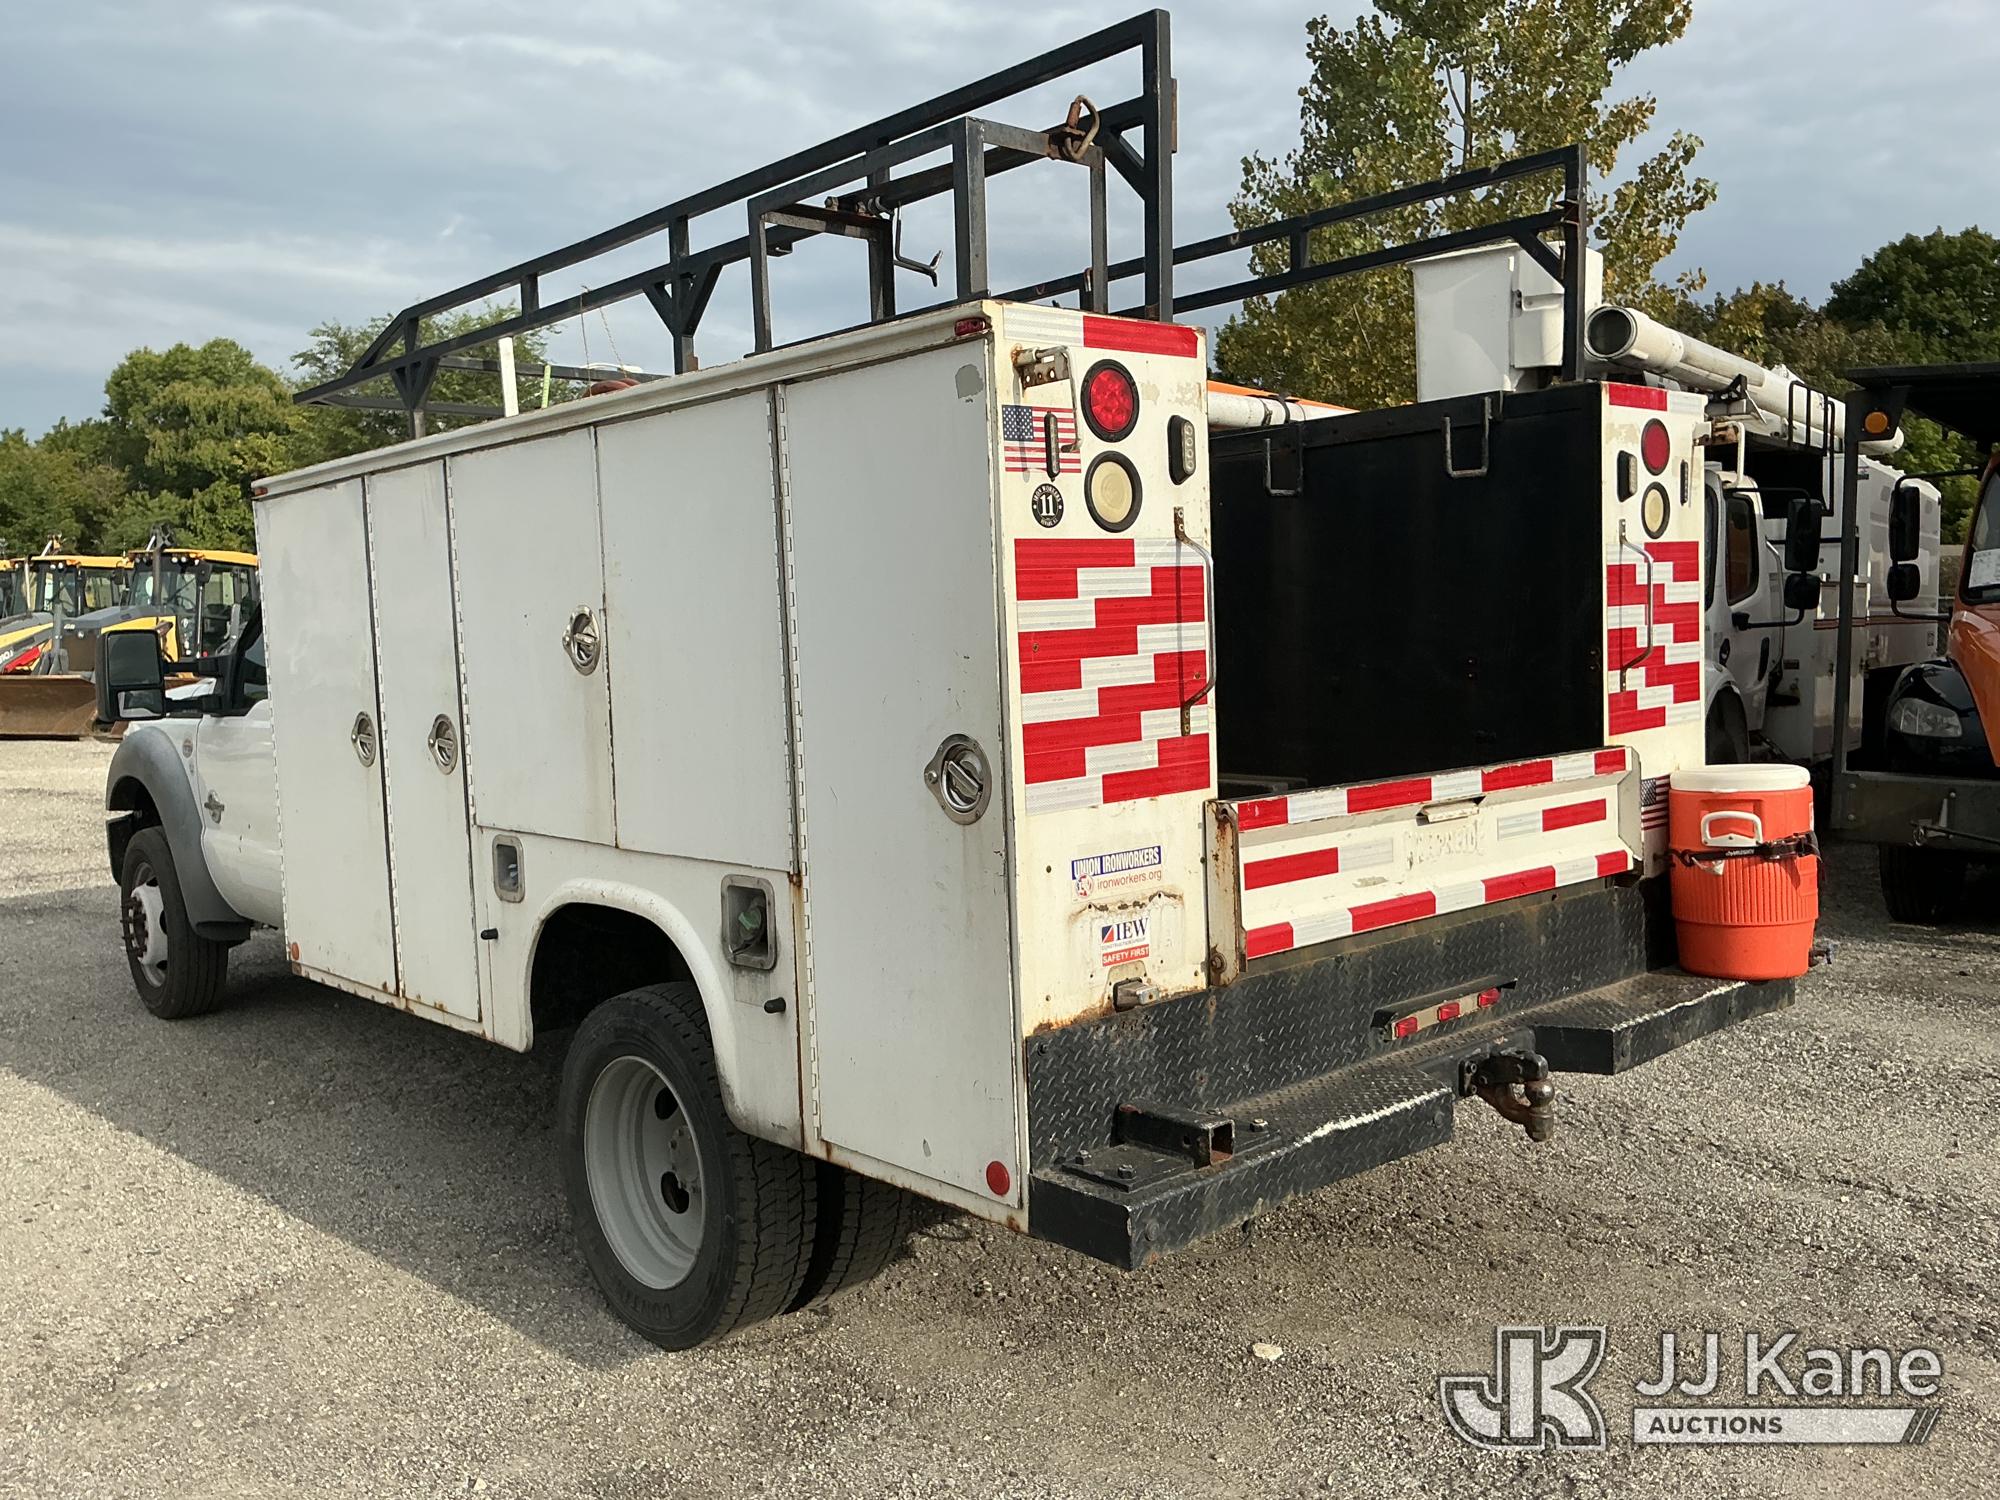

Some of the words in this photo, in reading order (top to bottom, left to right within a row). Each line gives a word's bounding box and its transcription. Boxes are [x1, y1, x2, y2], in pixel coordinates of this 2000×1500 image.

[1040, 494, 1056, 516] 11
[1074, 857, 1101, 878] UNION
[1102, 846, 1160, 873] IRONWORKERS
[1097, 870, 1162, 889] ironworkers.org
[1115, 917, 1149, 941] IEW
[1102, 950, 1130, 963] SAFETY
[1130, 946, 1149, 958] FIRST
